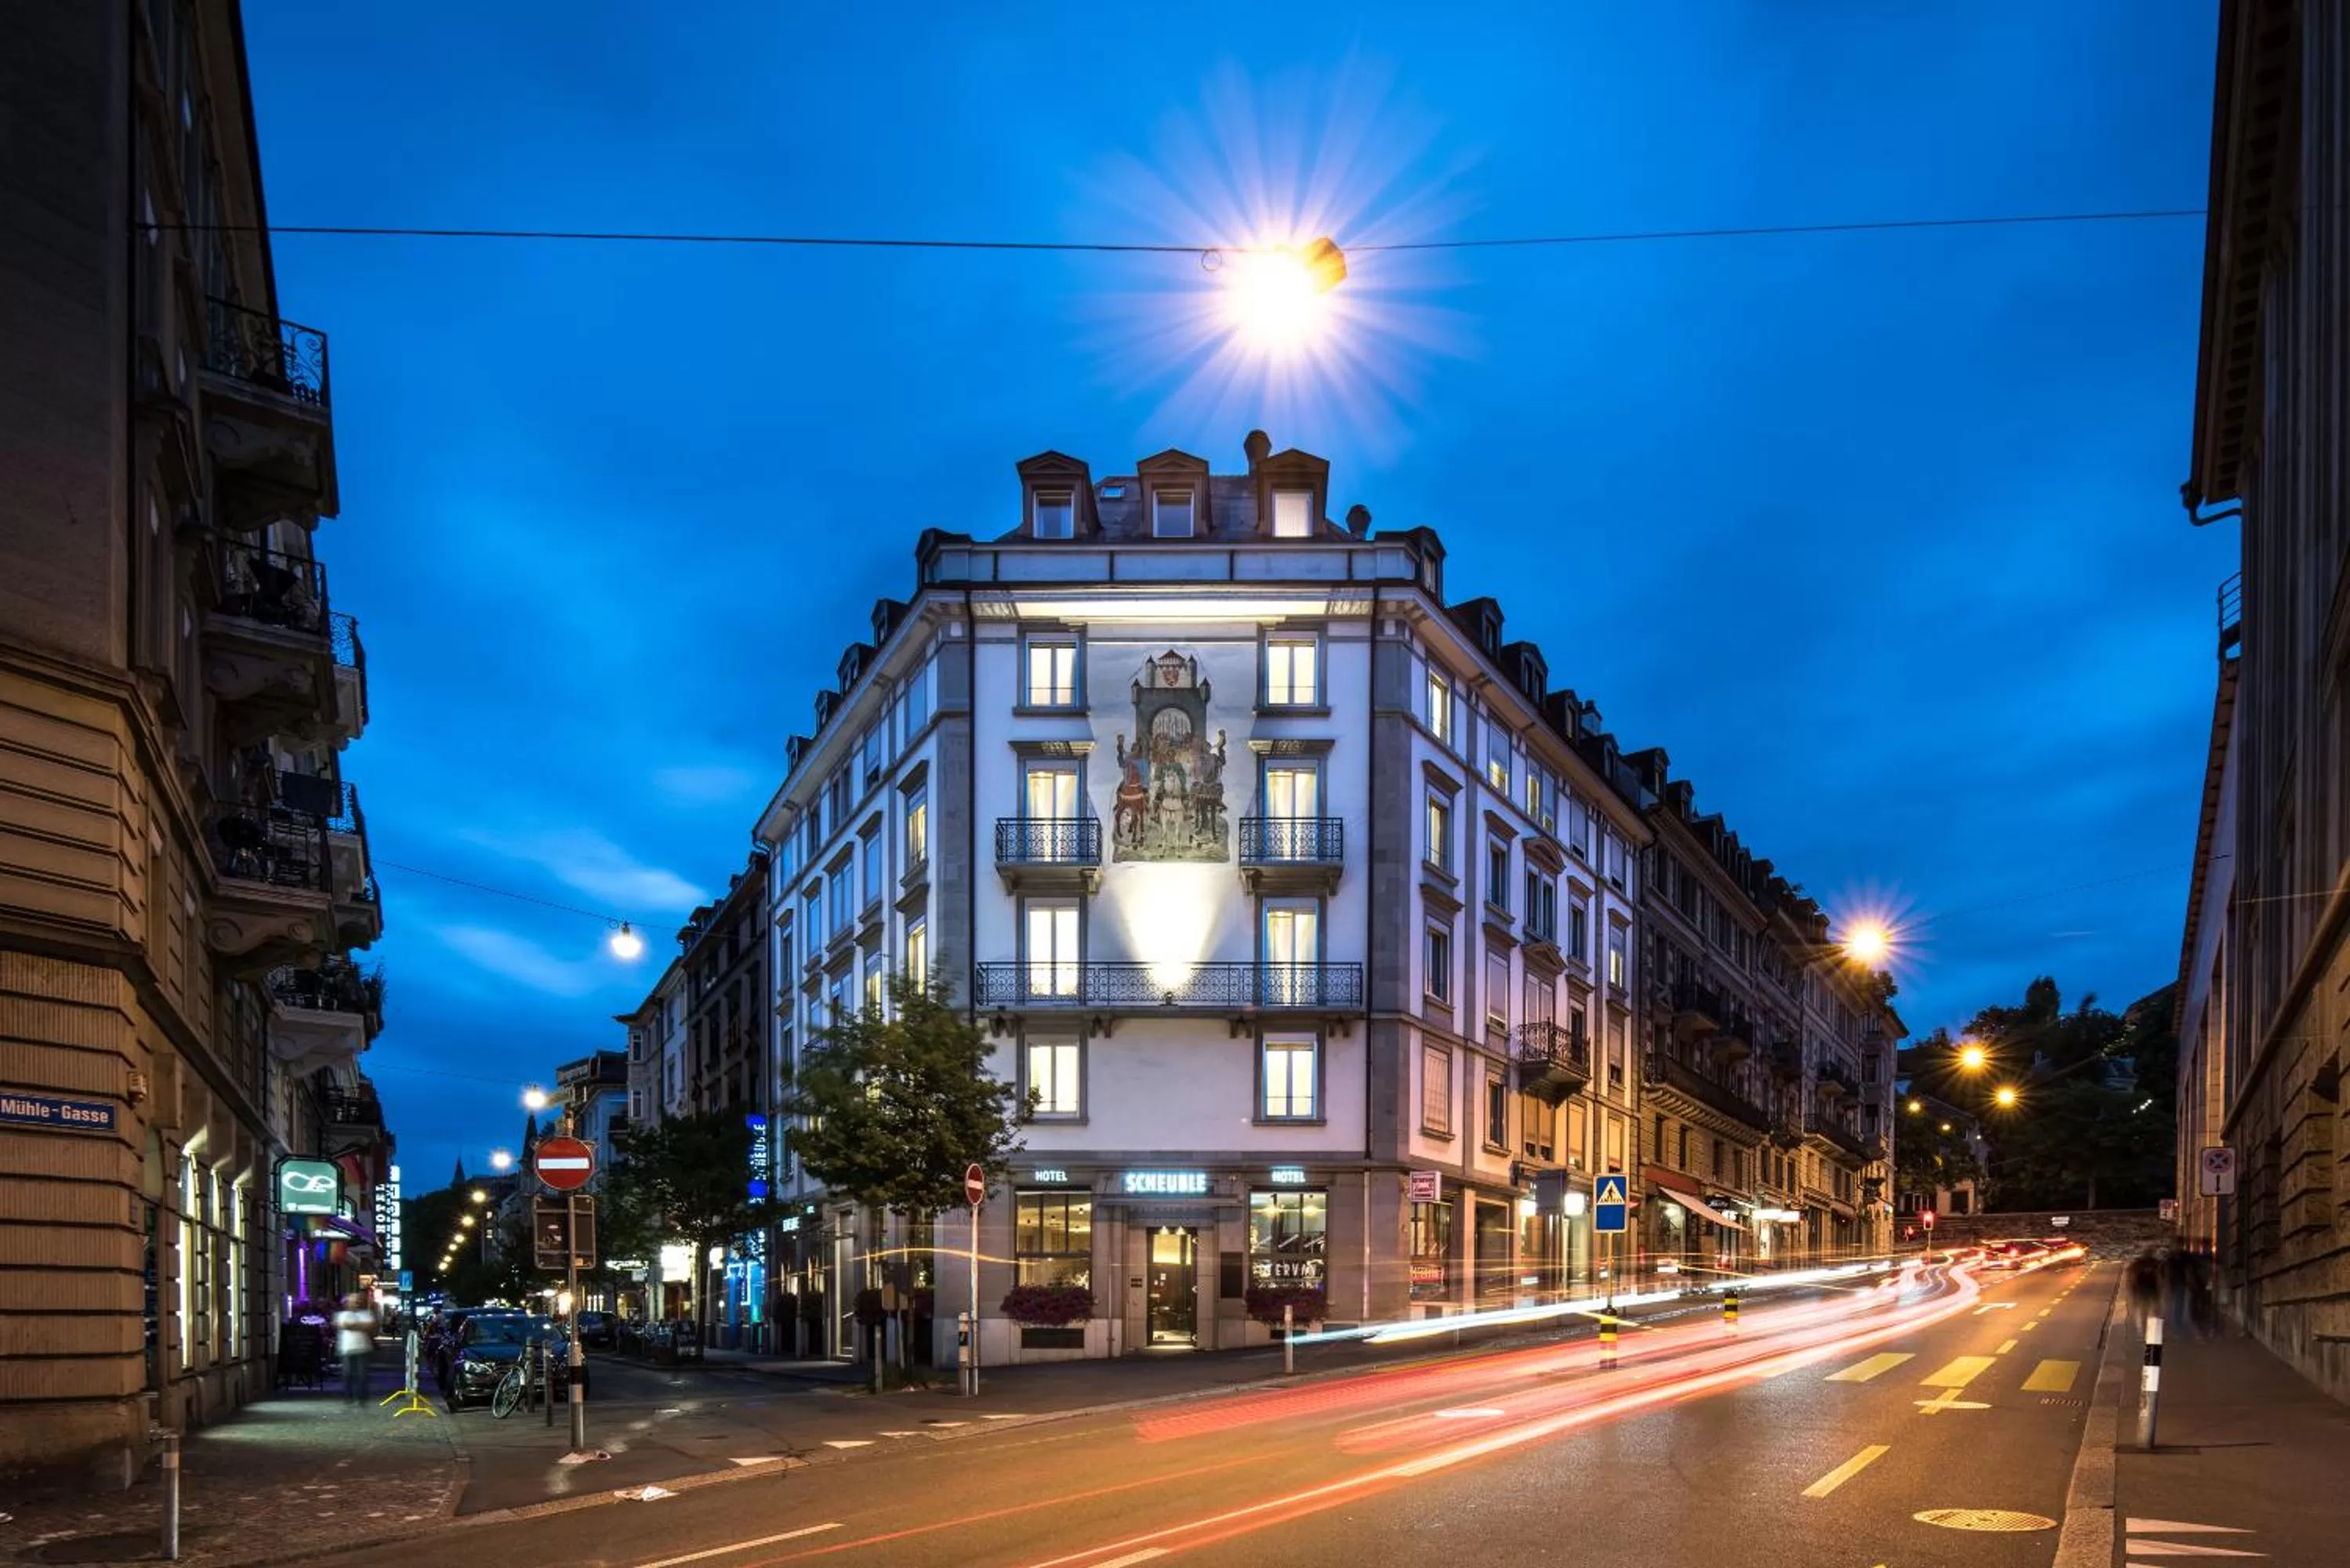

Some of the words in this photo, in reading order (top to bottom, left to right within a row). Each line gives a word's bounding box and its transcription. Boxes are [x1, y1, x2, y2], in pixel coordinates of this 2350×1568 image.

[1035, 1171, 1068, 1182] HOTEL
[1126, 1172, 1207, 1193] SCHEUBLE
[1271, 1170, 1306, 1182] HOTEL
[375, 1183, 386, 1233] HOTEL
